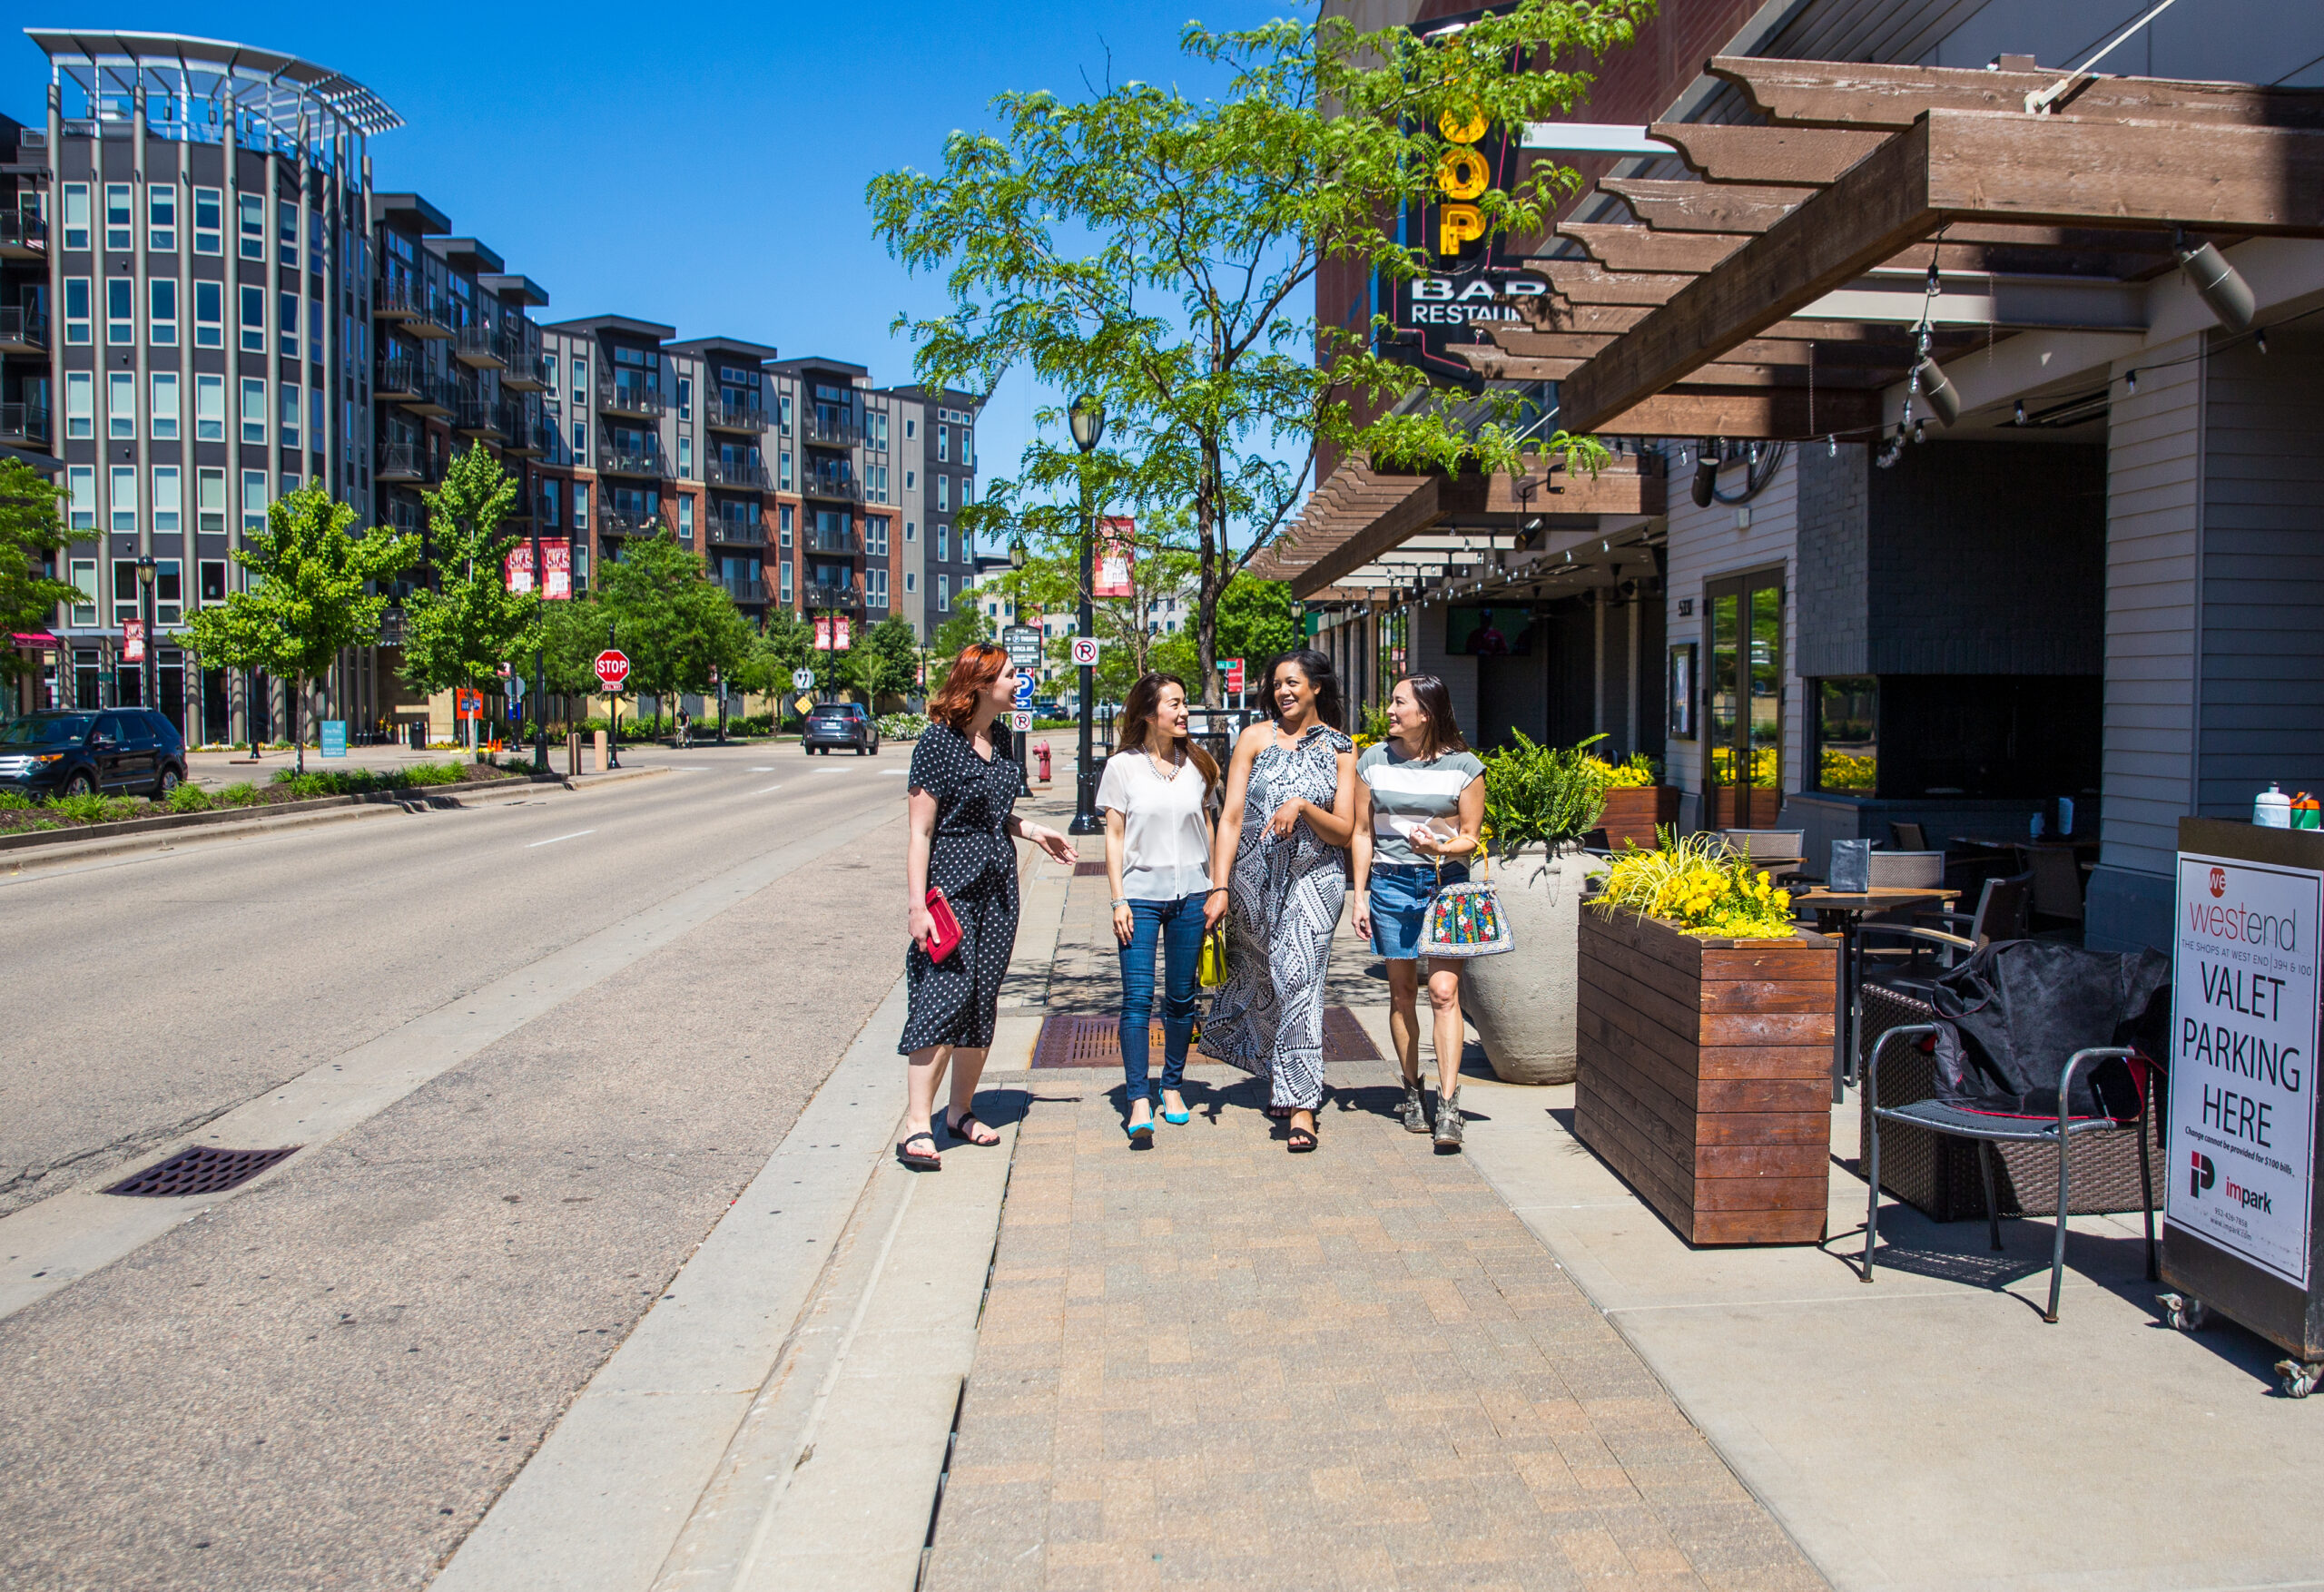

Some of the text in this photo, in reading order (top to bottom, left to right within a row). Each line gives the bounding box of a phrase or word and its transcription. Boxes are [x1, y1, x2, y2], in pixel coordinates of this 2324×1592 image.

[509, 553, 530, 565] LIFE
[547, 552, 567, 564] LIFE
[598, 660, 626, 673] STOP
[2190, 901, 2296, 952] westend
[2181, 938, 2312, 976] THE SHOPS AT WEST END 394 & 100
[2201, 960, 2286, 1023] VALET
[2182, 1017, 2300, 1093] PARKING
[2202, 1083, 2272, 1148] HERE
[2185, 1125, 2204, 1141] Change
[2204, 1135, 2223, 1146] cannot
[2223, 1140, 2230, 1150] be
[2230, 1145, 2255, 1160] provided
[2255, 1152, 2264, 1163] for
[2264, 1156, 2280, 1169] $100
[2226, 1175, 2271, 1214] impark
